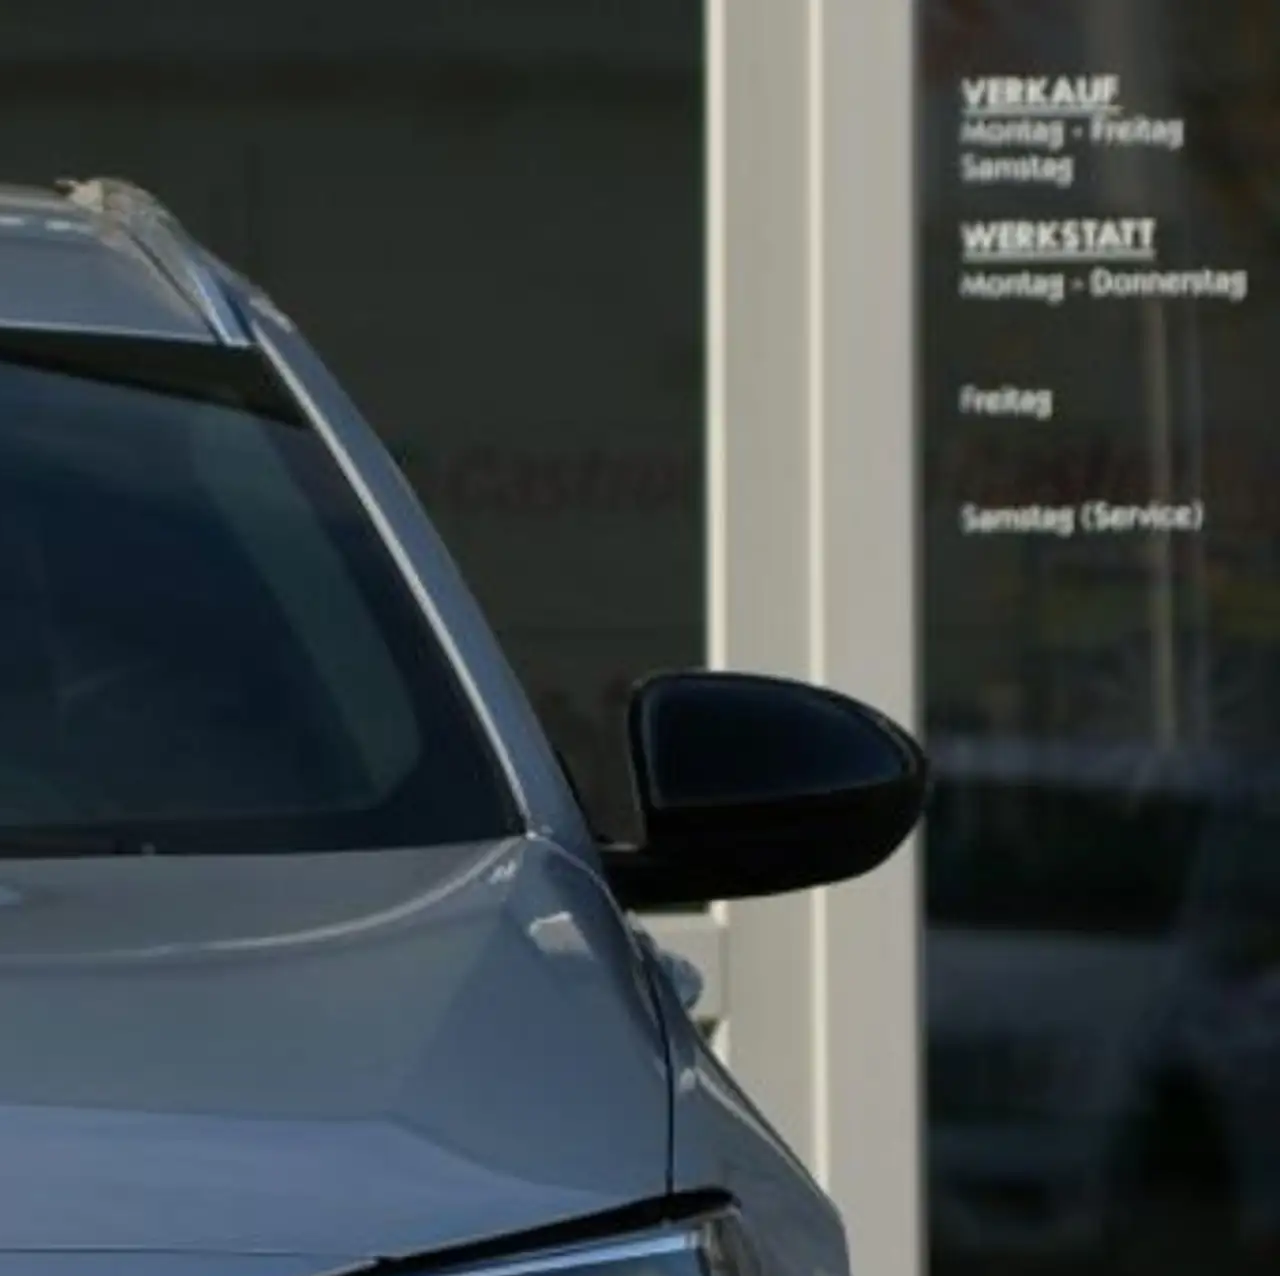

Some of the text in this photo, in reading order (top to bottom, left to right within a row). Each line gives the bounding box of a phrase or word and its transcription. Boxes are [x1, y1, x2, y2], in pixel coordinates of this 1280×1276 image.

[960, 75, 1120, 108] VERKAUF
[960, 117, 1064, 149] Montag
[1090, 115, 1184, 148] Freitag
[960, 153, 1074, 187] Samstag
[961, 218, 1156, 251] WERKSTATT
[960, 270, 1064, 303] Montag
[1090, 268, 1247, 301] Donnerstag
[958, 385, 1053, 419] Freitag
[960, 499, 1204, 536] Samstag (Service)
